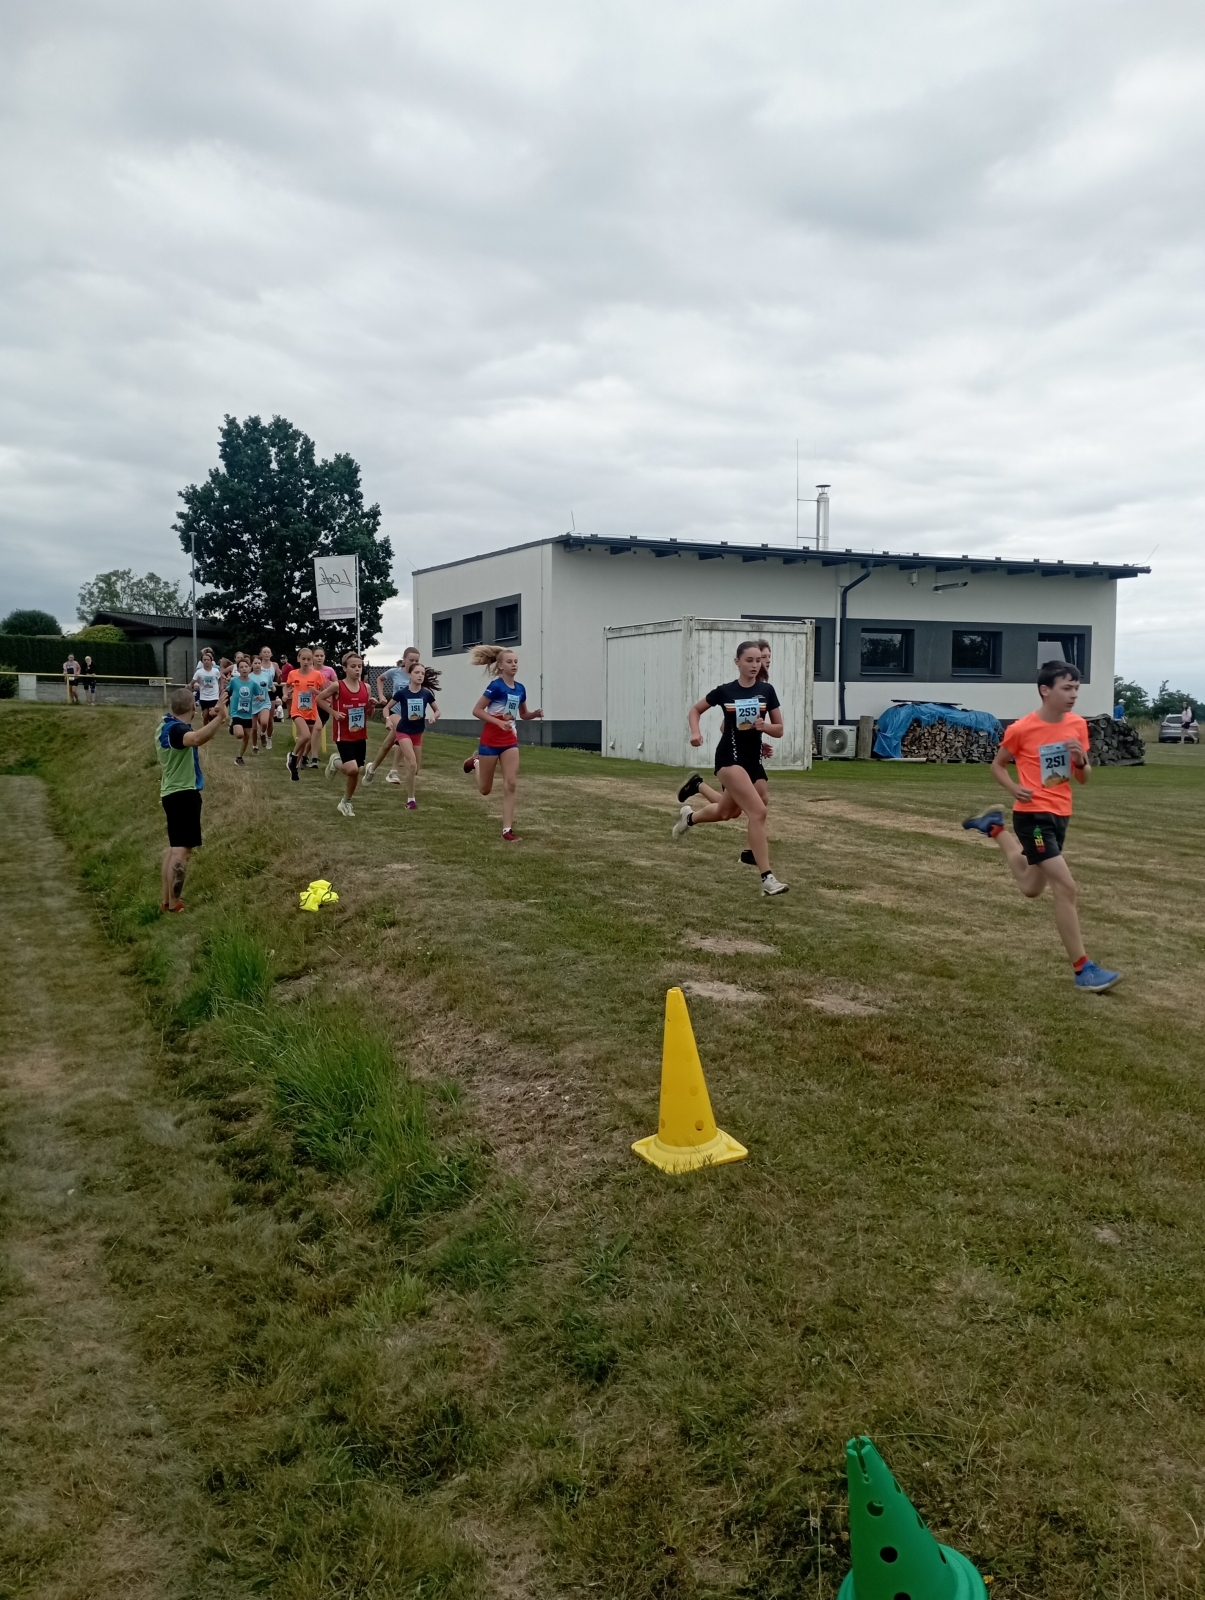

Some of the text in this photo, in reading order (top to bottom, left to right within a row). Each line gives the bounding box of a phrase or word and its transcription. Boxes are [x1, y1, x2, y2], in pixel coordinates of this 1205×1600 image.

[411, 704, 421, 712] 151
[738, 707, 758, 717] 253
[351, 714, 362, 722] 157
[1045, 754, 1066, 770] 251
